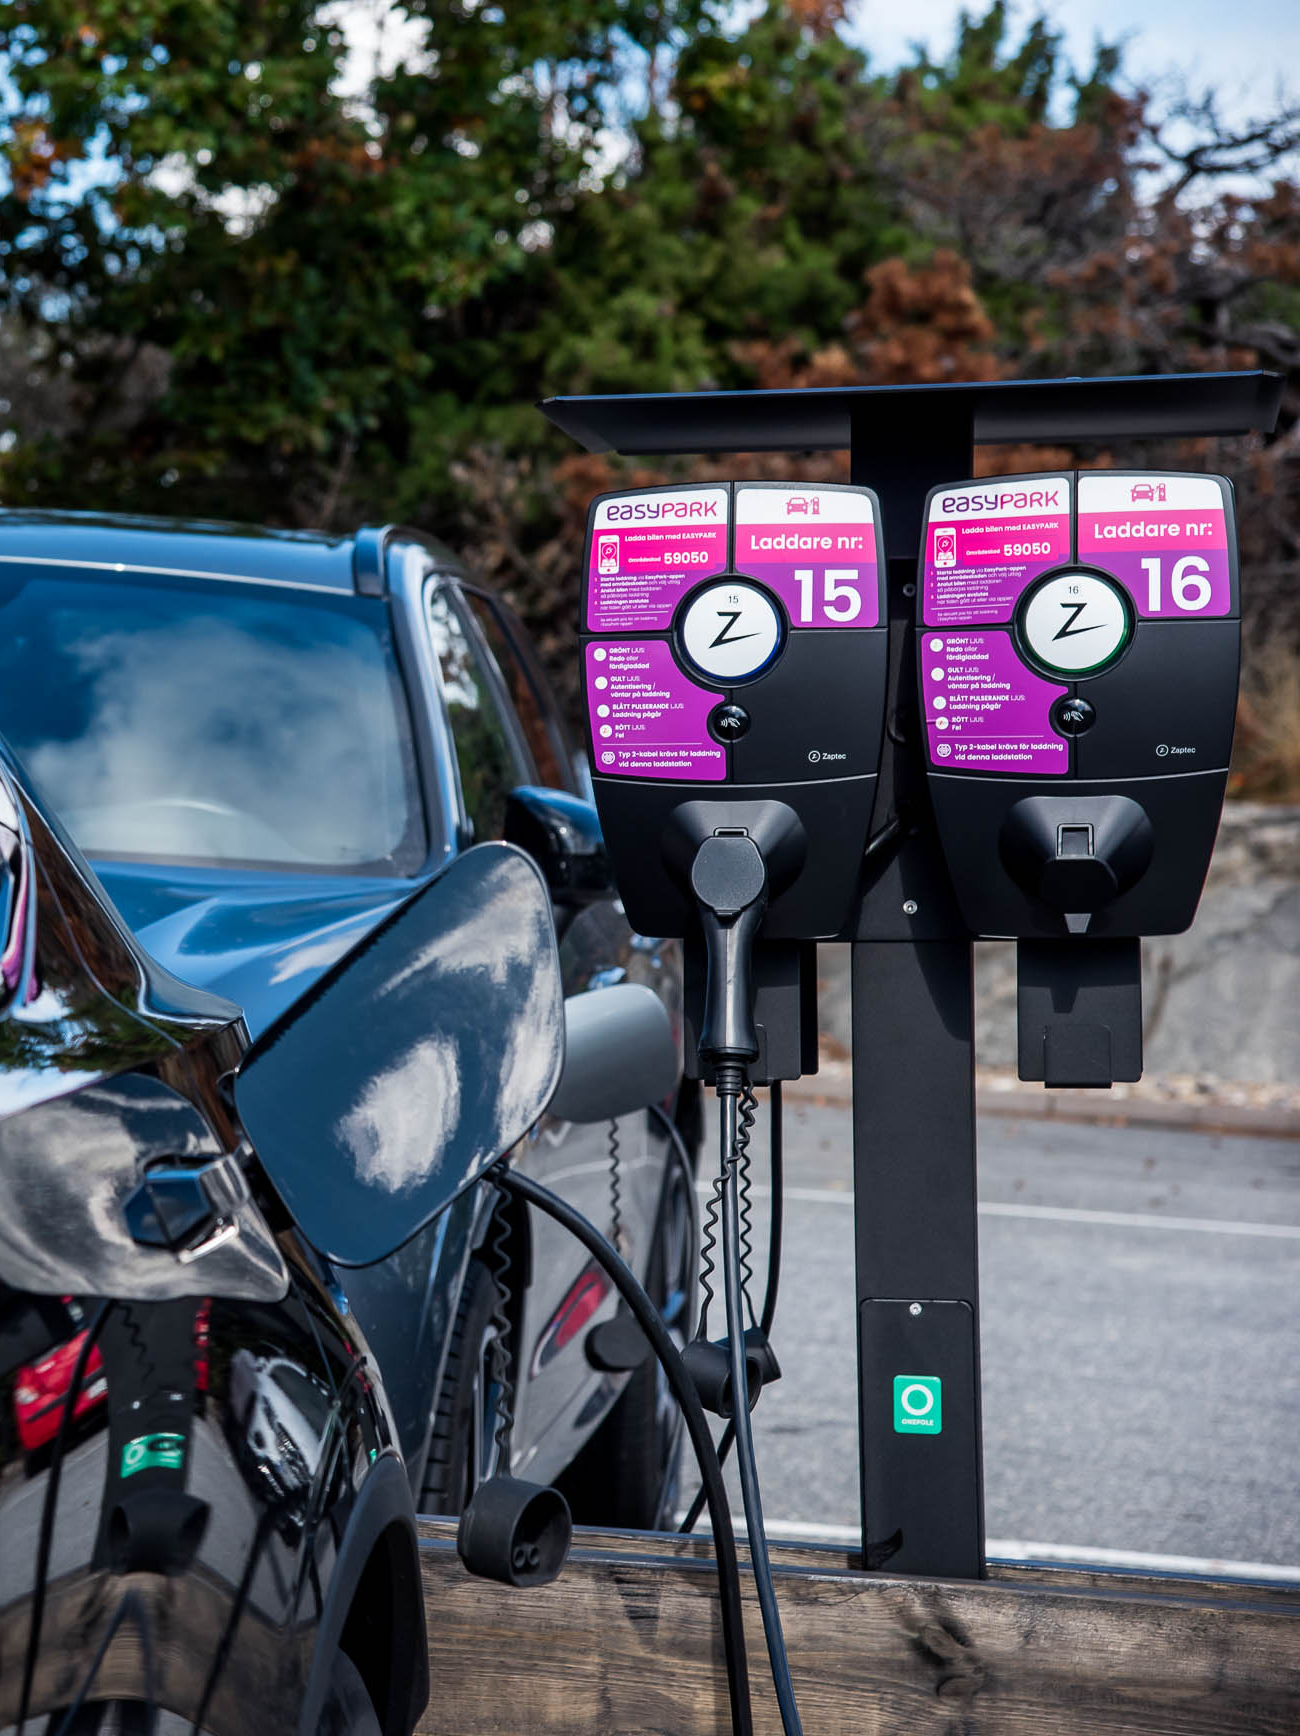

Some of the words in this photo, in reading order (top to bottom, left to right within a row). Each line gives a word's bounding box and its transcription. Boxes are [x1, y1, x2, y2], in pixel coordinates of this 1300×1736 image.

[985, 525, 1003, 533] bilen
[1023, 522, 1058, 530] EASYPARK
[1094, 521, 1181, 539] Laddare
[1186, 521, 1212, 536] nr:
[751, 535, 832, 550] Laddare
[837, 535, 863, 550] nr:
[1003, 542, 1050, 556] 59050
[664, 551, 708, 564] 59050
[1140, 555, 1212, 612] 16
[794, 569, 862, 623] 15
[1068, 586, 1079, 595] 16
[729, 595, 738, 603] 15
[1170, 746, 1196, 755] Zaptec
